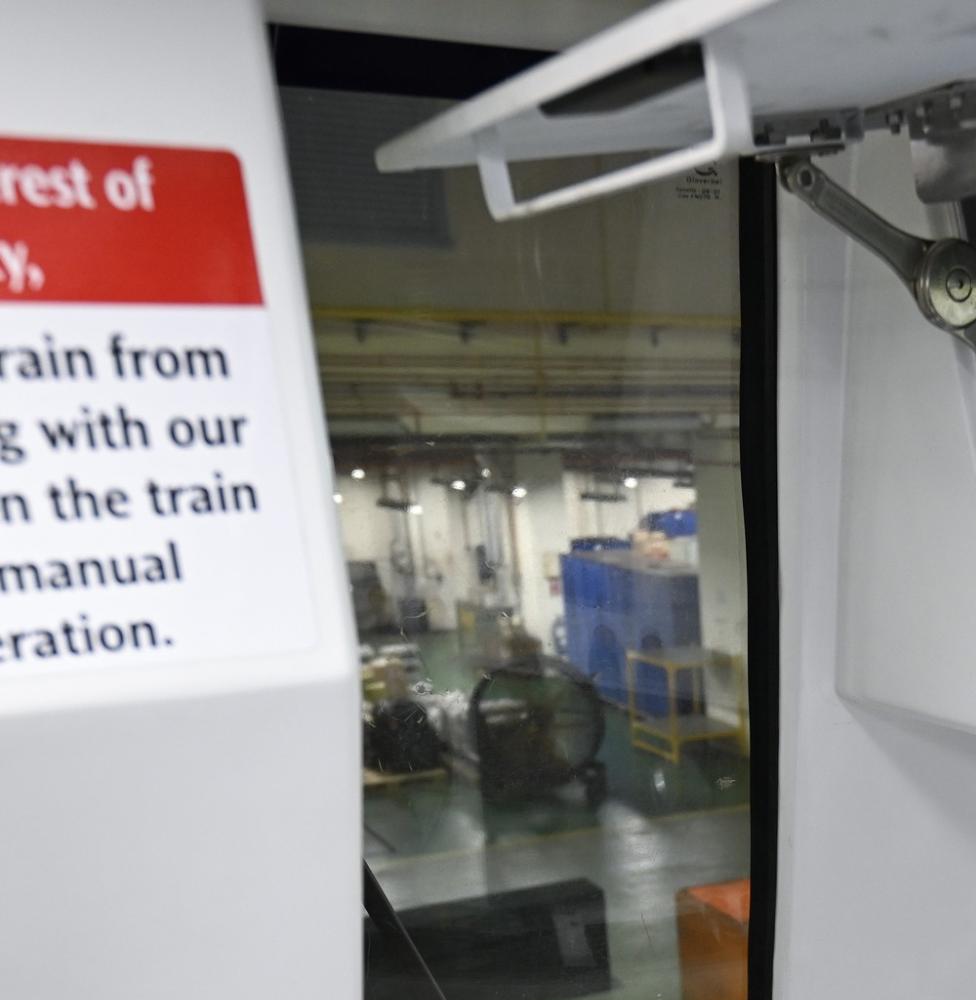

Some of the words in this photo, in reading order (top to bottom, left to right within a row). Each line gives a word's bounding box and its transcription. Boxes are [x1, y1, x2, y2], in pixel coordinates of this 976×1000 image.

[0, 157, 98, 210] rest
[103, 155, 156, 212] of
[0, 239, 45, 293] y,
[108, 332, 229, 379] from
[38, 404, 150, 449] with
[168, 415, 248, 448] our
[0, 493, 31, 523] n
[47, 475, 130, 521] the
[147, 470, 259, 517] train
[0, 539, 183, 592] manual
[0, 613, 174, 662] ration.
